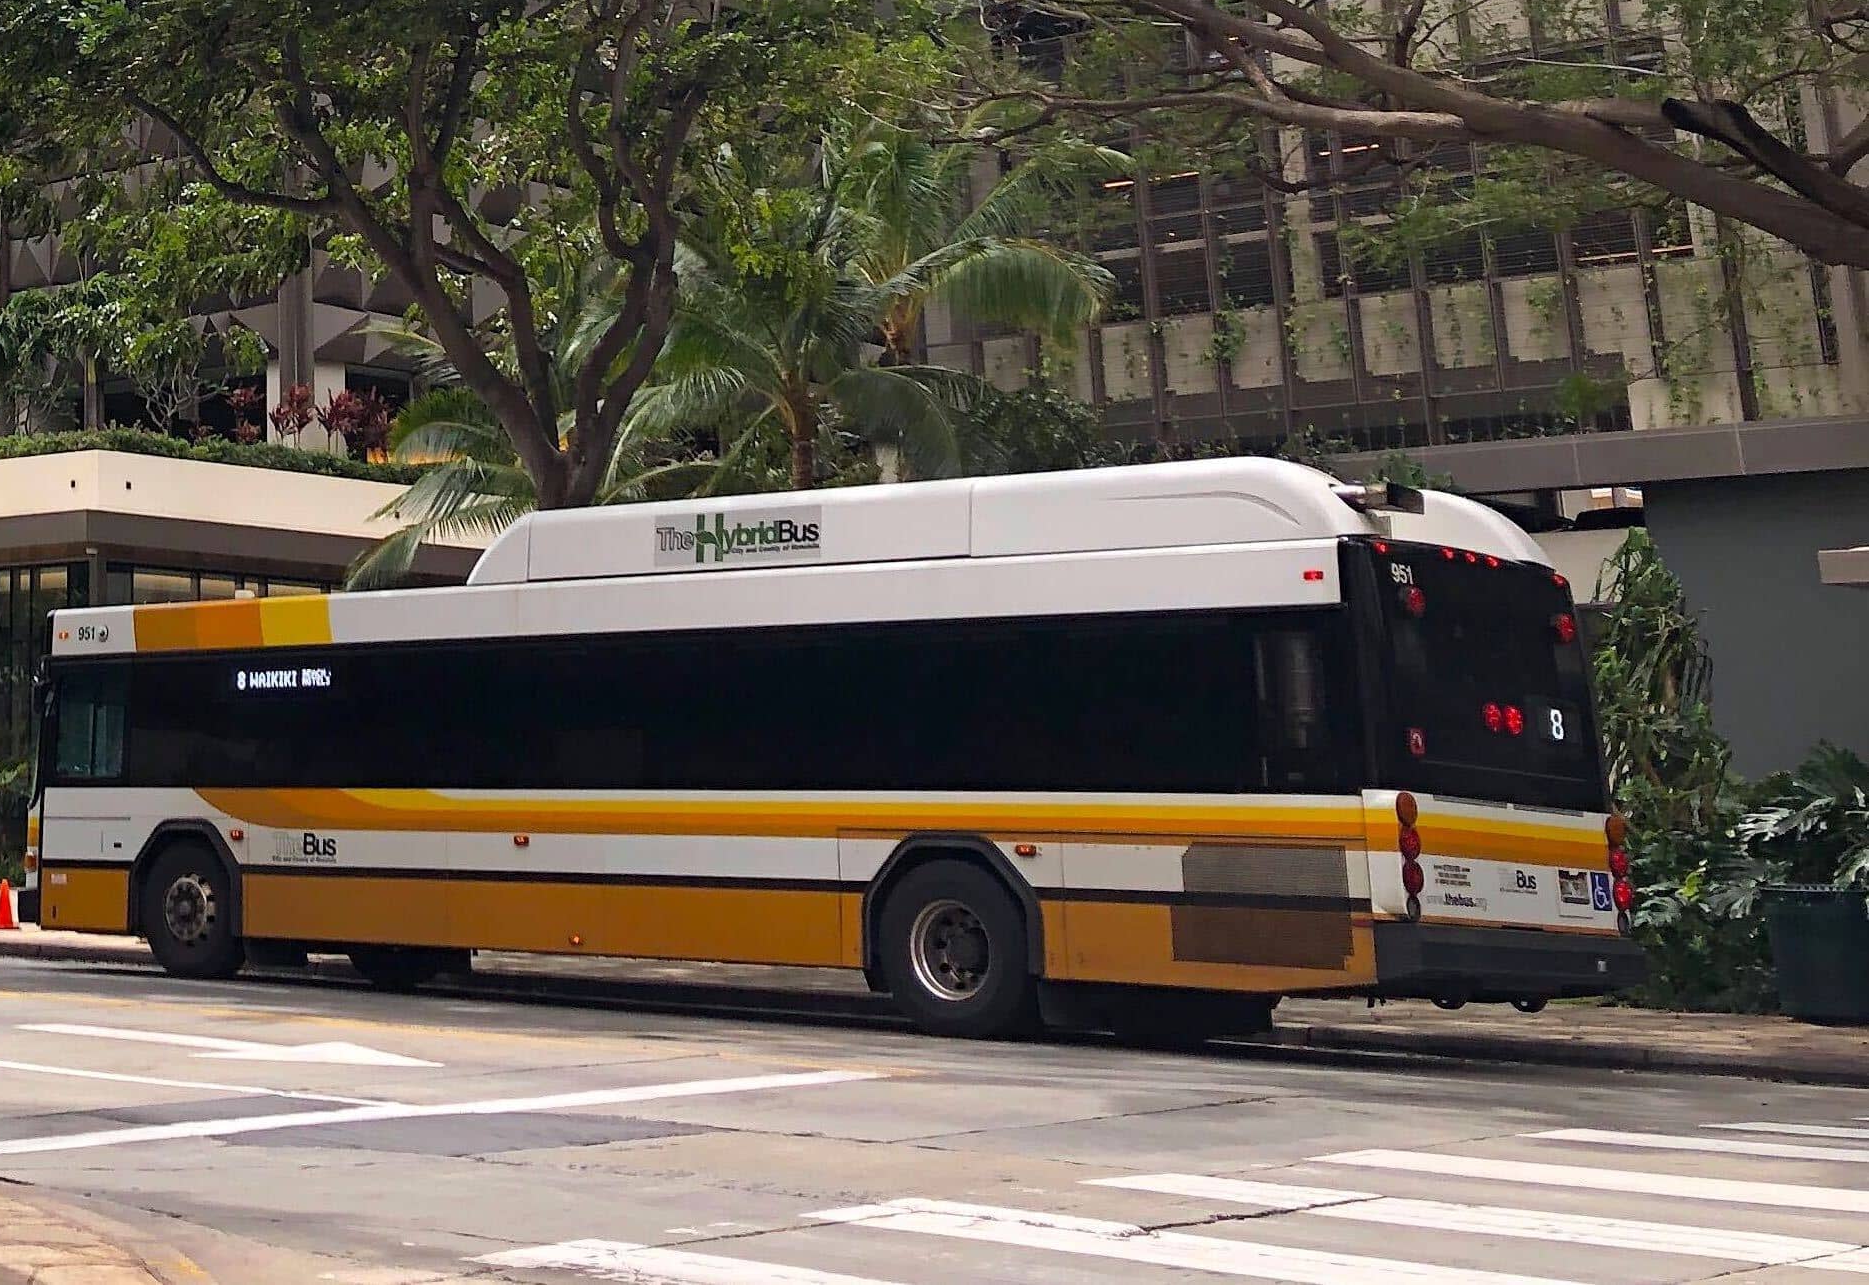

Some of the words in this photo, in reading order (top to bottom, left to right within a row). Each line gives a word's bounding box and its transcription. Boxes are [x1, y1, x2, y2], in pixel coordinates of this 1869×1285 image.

[1391, 562, 1414, 585] 951
[78, 626, 95, 641] 951
[236, 670, 247, 691] 8
[249, 670, 298, 689] WAIKIKI
[1550, 708, 1565, 741] 8
